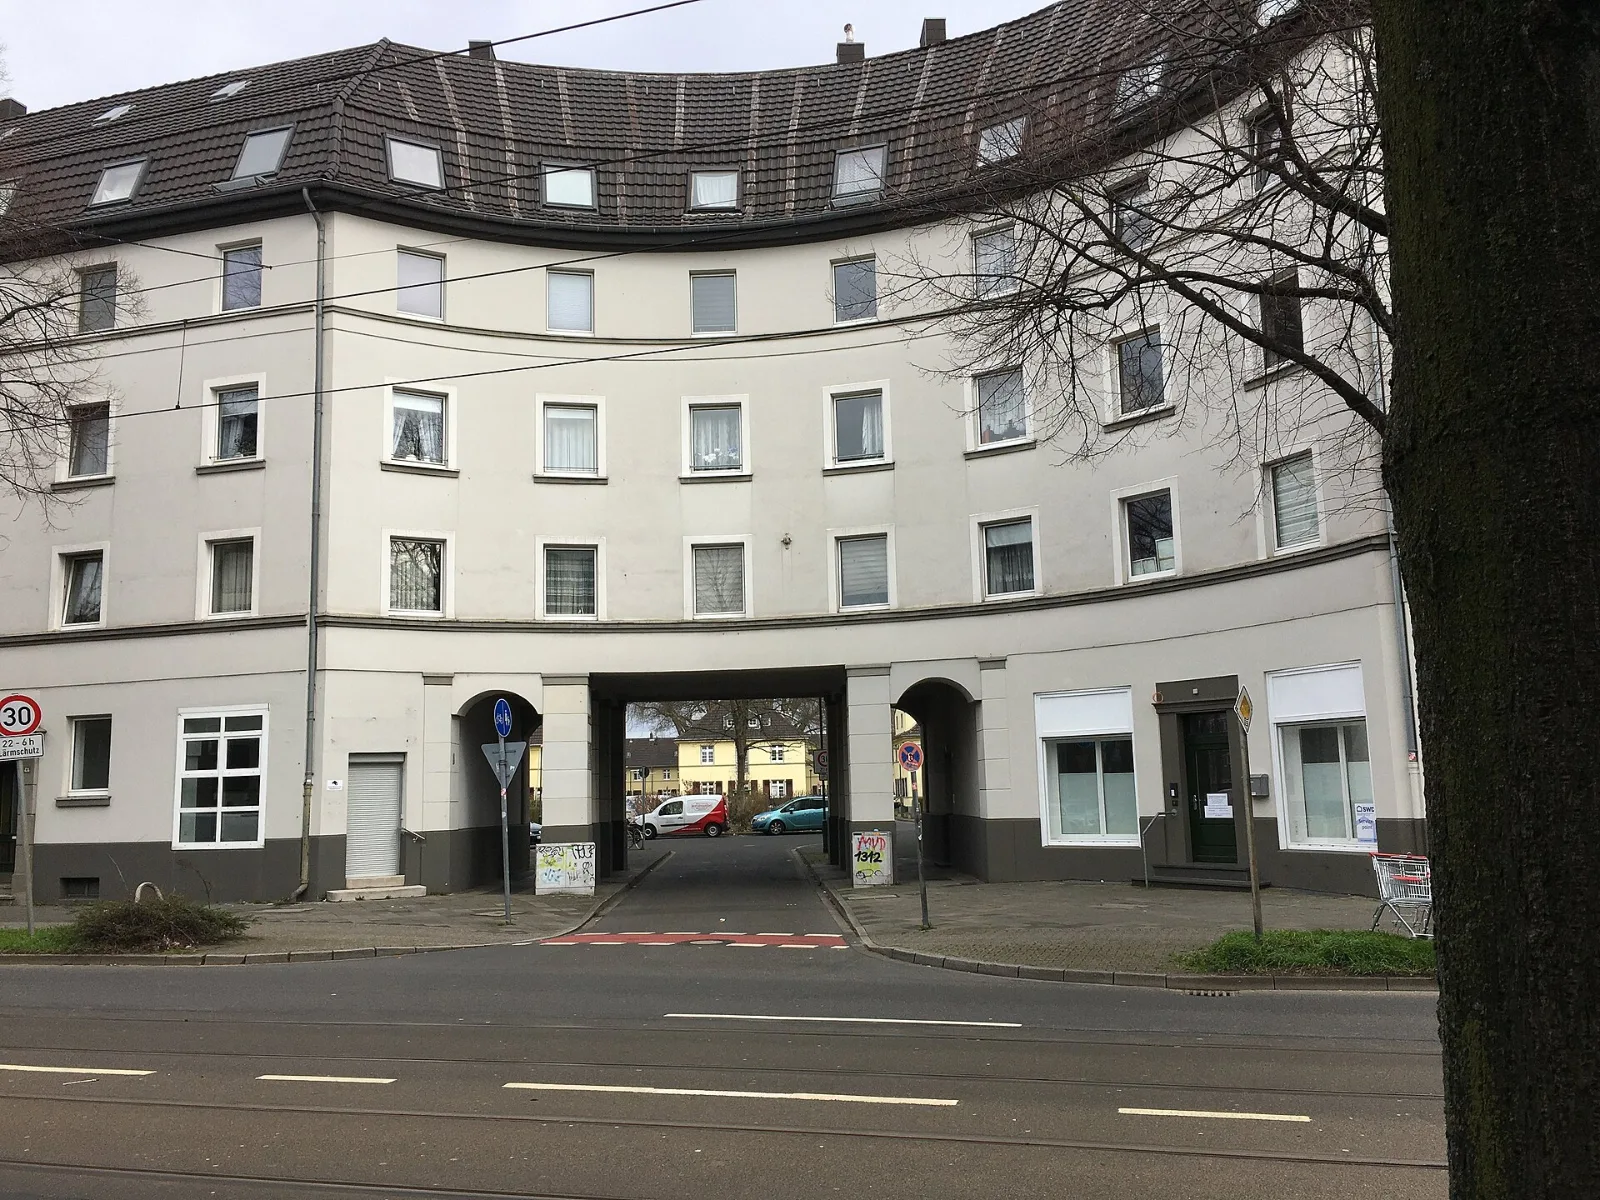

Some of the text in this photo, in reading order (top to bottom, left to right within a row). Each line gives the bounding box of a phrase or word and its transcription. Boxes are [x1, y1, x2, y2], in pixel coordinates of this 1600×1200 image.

[3, 706, 31, 727] 30
[2, 739, 14, 748] 22
[854, 850, 883, 863] 1312
